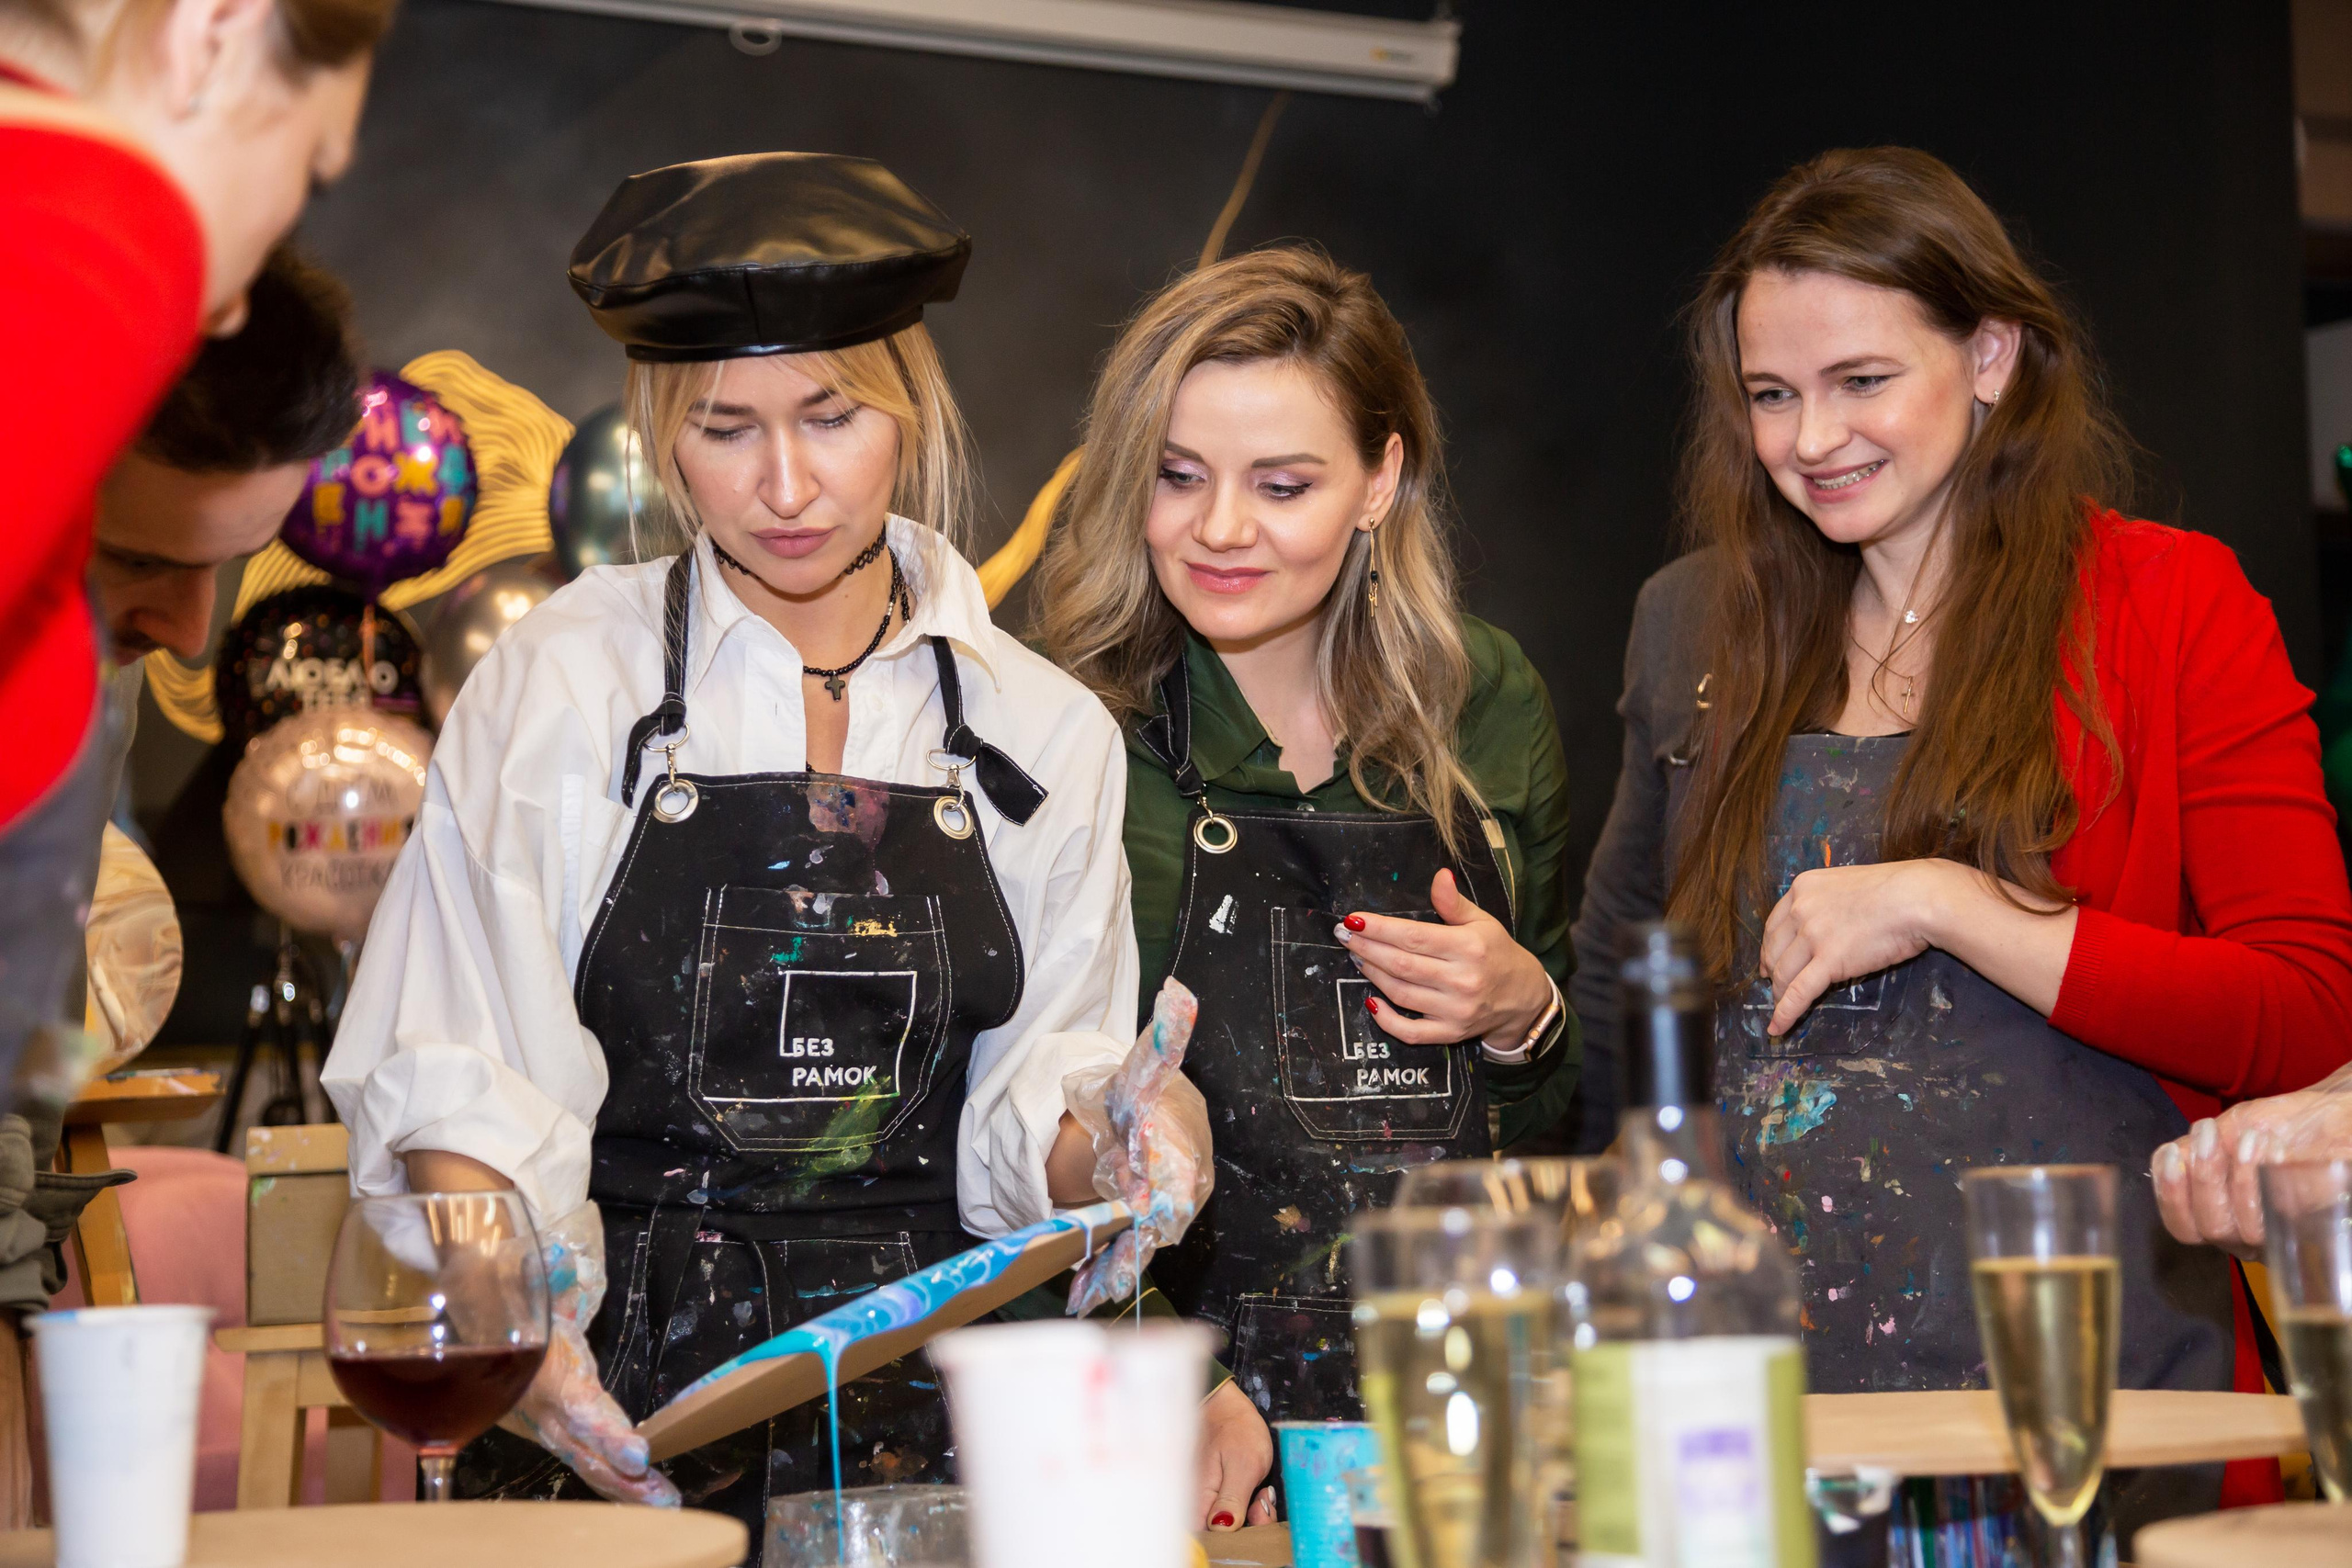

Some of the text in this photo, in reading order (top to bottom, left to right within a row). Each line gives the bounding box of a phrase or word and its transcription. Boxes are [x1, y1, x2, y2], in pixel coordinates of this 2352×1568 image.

[792, 1037, 834, 1057] БЕЗ
[1353, 1042, 1391, 1059] БЕЗ
[792, 1066, 877, 1087] РАМОК
[1357, 1067, 1430, 1086] РАМОК
